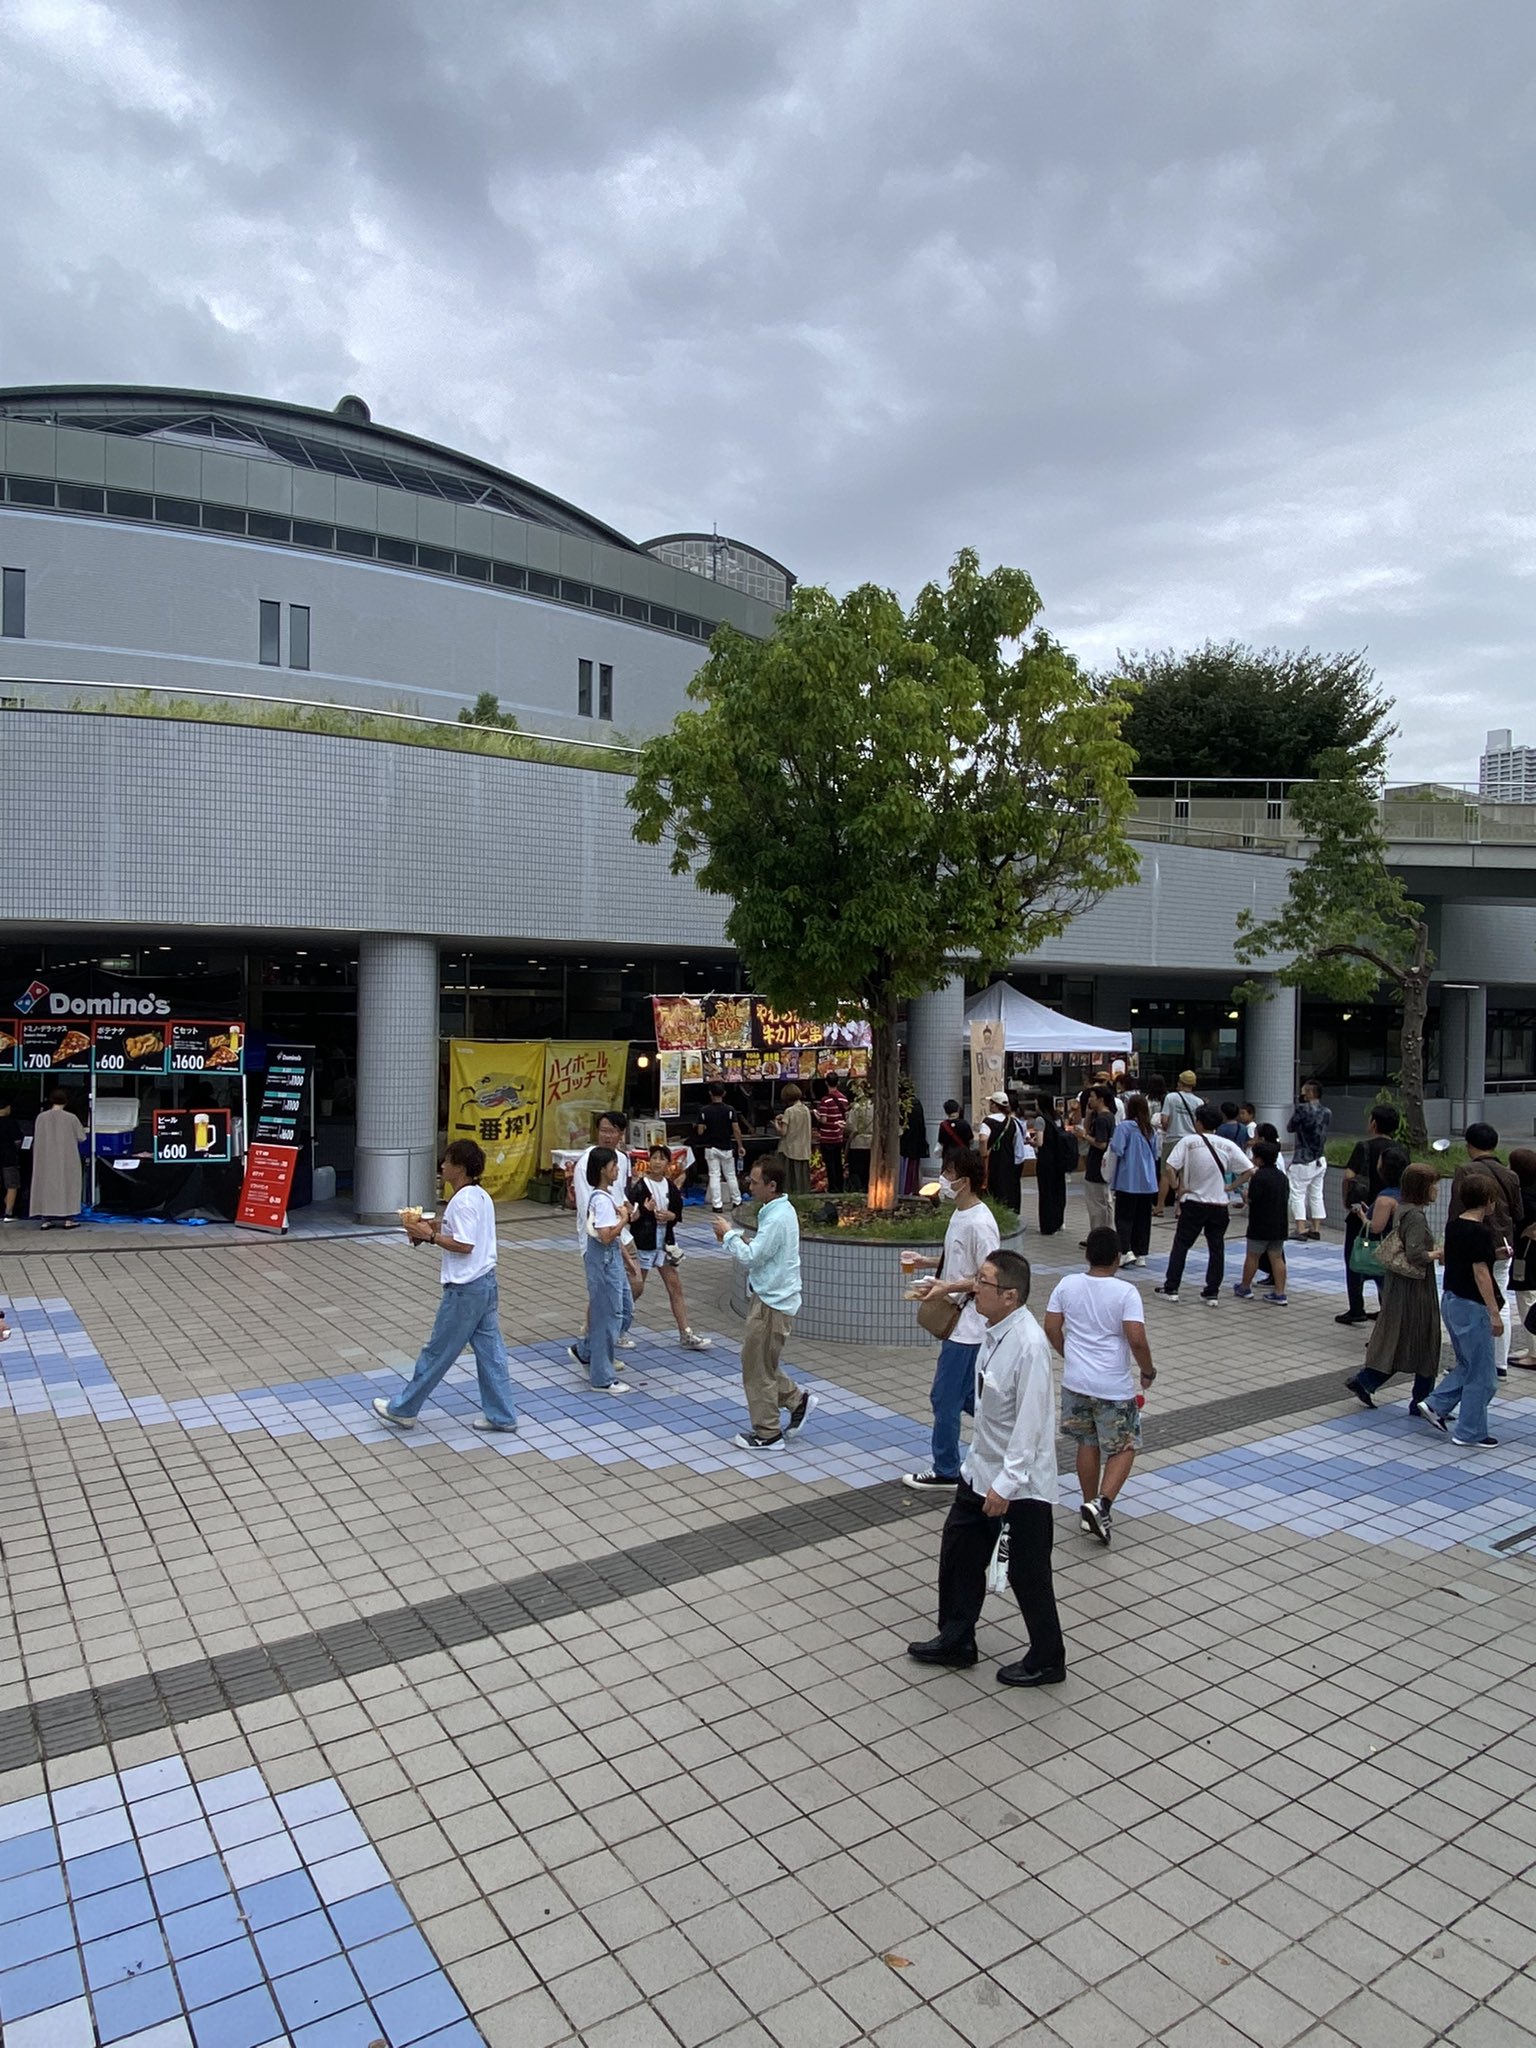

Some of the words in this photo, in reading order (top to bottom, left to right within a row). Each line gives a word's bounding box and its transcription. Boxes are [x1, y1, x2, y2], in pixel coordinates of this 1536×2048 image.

[50, 992, 171, 1015] Domino's
[172, 1026, 198, 1035] Cセット
[762, 1024, 823, 1045] 牛カルビ串
[23, 1053, 51, 1069] ¥700
[96, 1054, 125, 1070] ¥600
[172, 1054, 204, 1070] ¥1600
[158, 1116, 178, 1124] ビール
[455, 1109, 538, 1141] 一番搾り
[158, 1144, 187, 1159] ¥600
